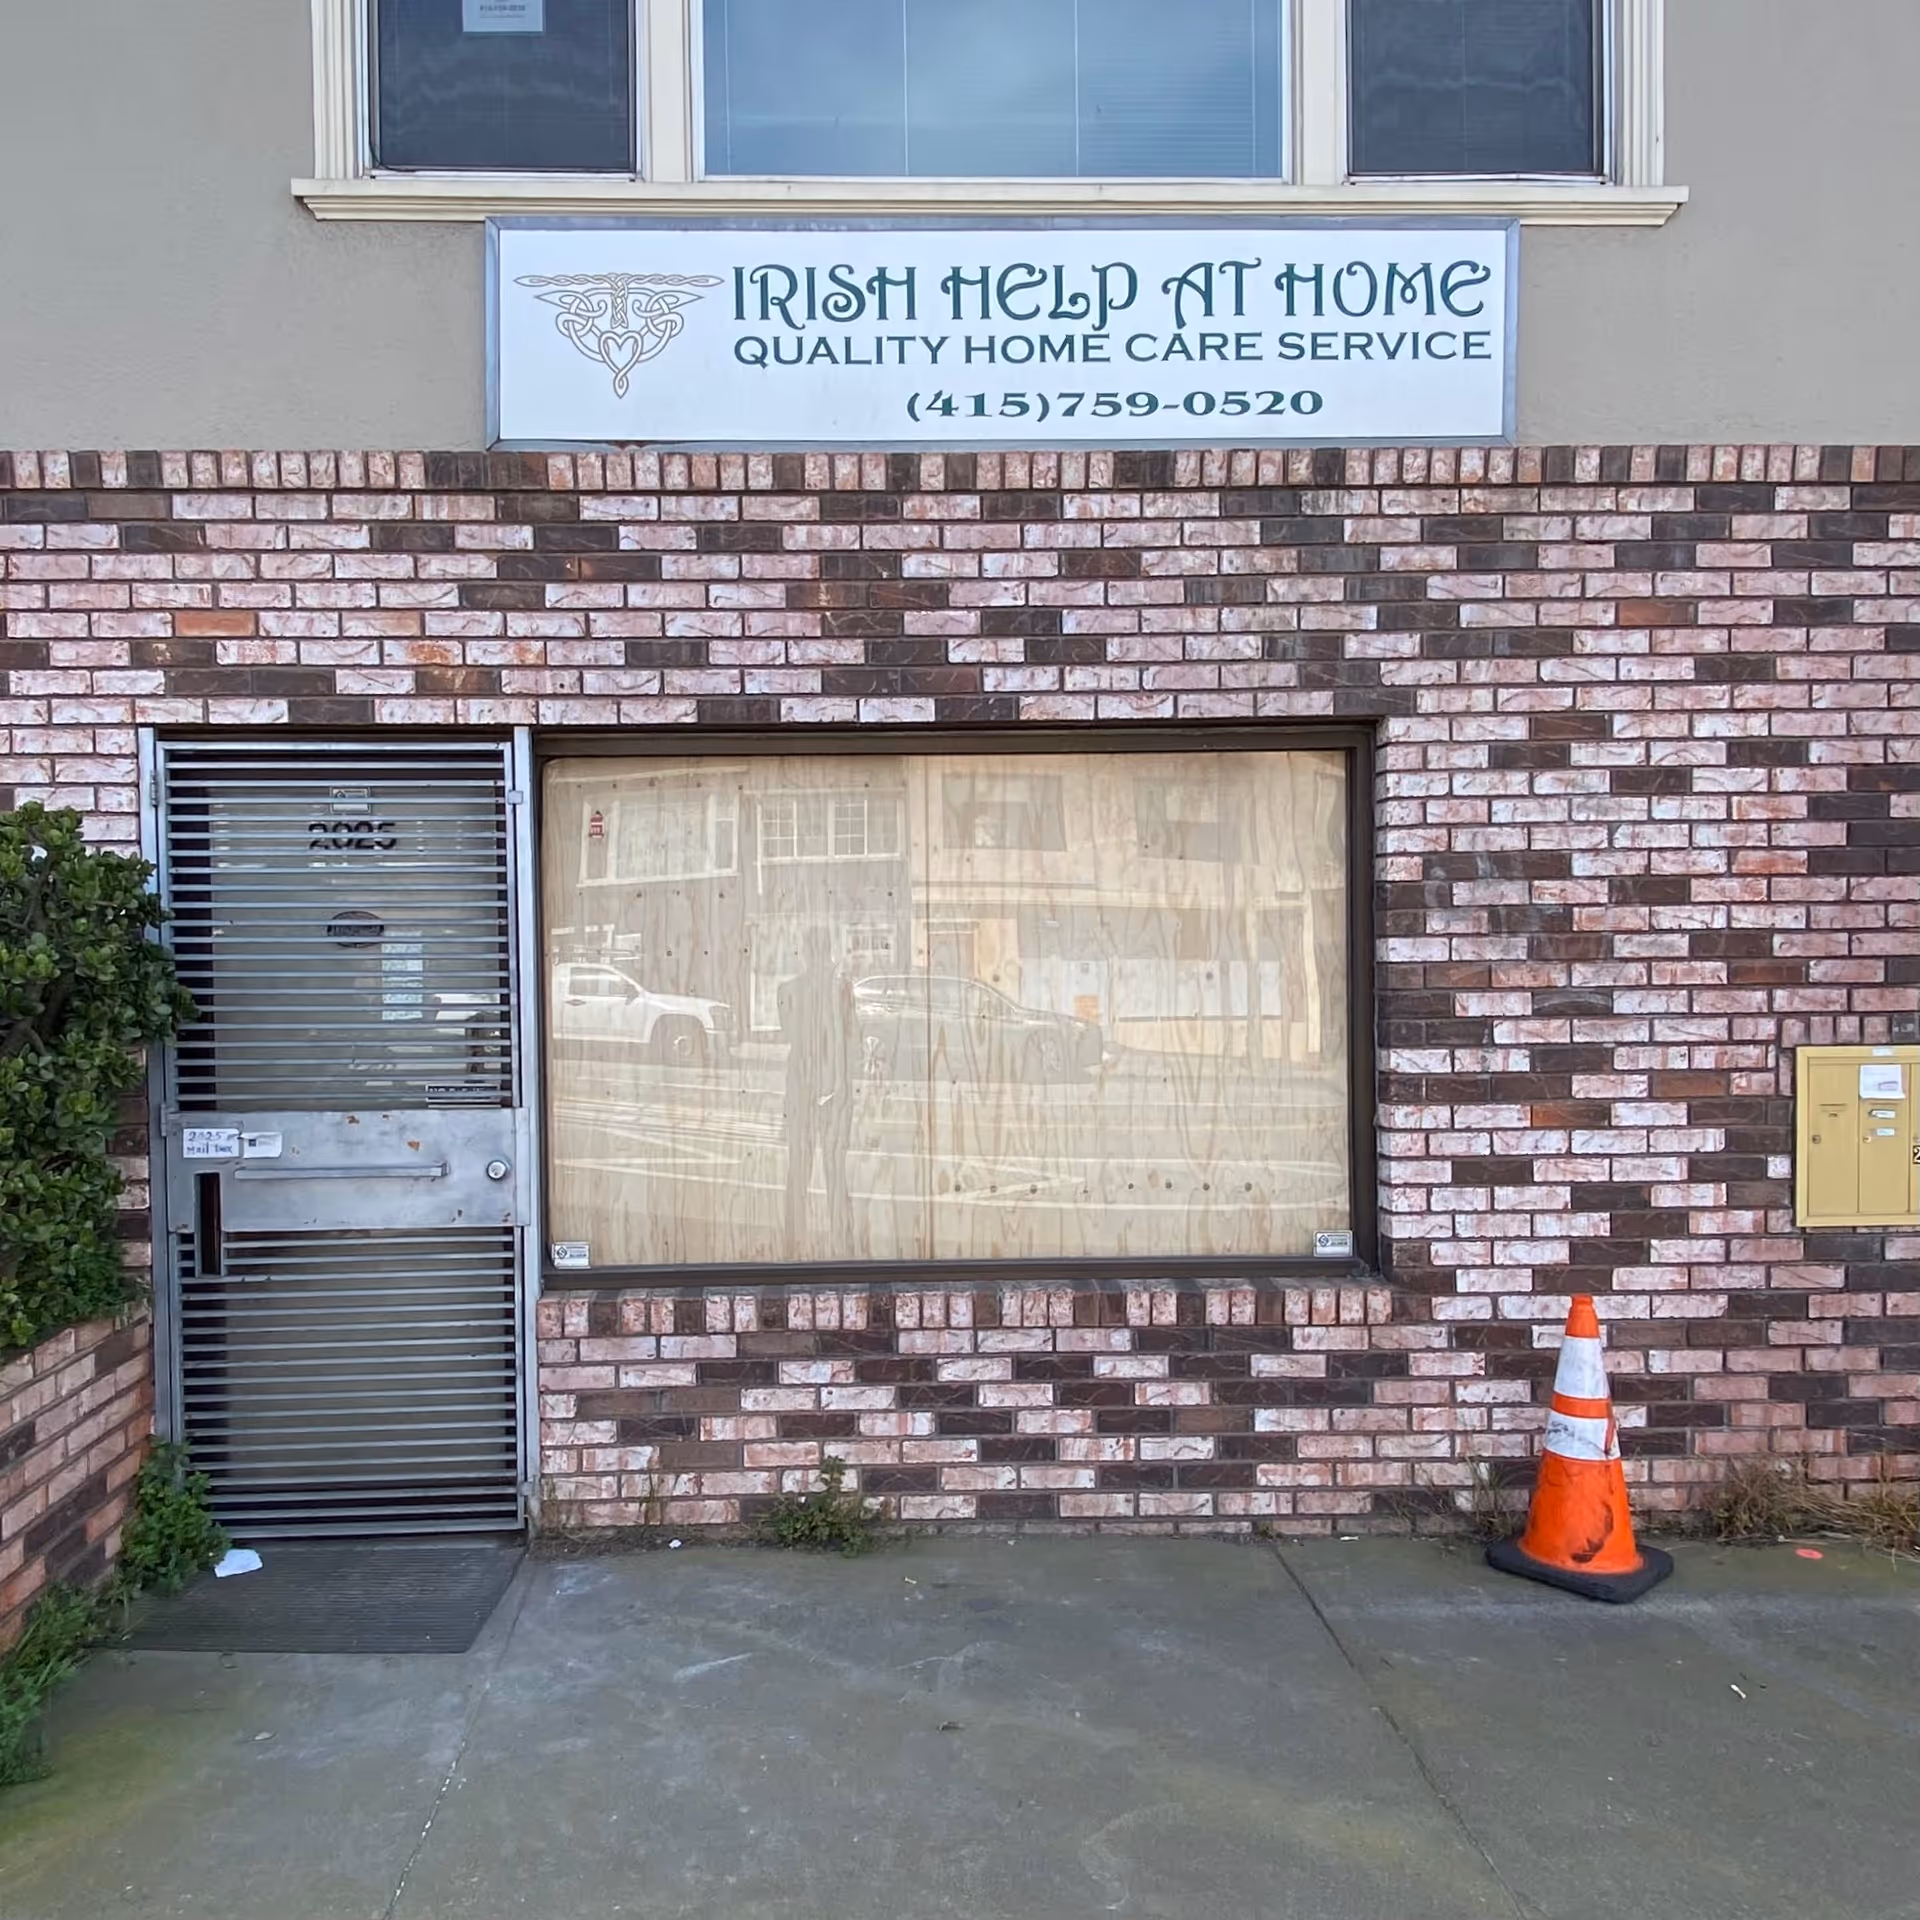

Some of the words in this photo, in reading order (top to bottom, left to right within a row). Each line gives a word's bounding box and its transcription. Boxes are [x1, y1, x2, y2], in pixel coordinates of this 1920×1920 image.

[733, 264, 917, 330] IRISH
[940, 262, 1138, 331] HELP
[1161, 257, 1262, 329] AT
[1274, 260, 1491, 317] HOME
[734, 335, 950, 369] QUALITY
[964, 333, 1111, 364] HOME
[1125, 332, 1263, 363] CARE
[1277, 331, 1492, 361] SERVICE
[906, 390, 1324, 423] (415)759-0520
[308, 820, 397, 850] 2025
